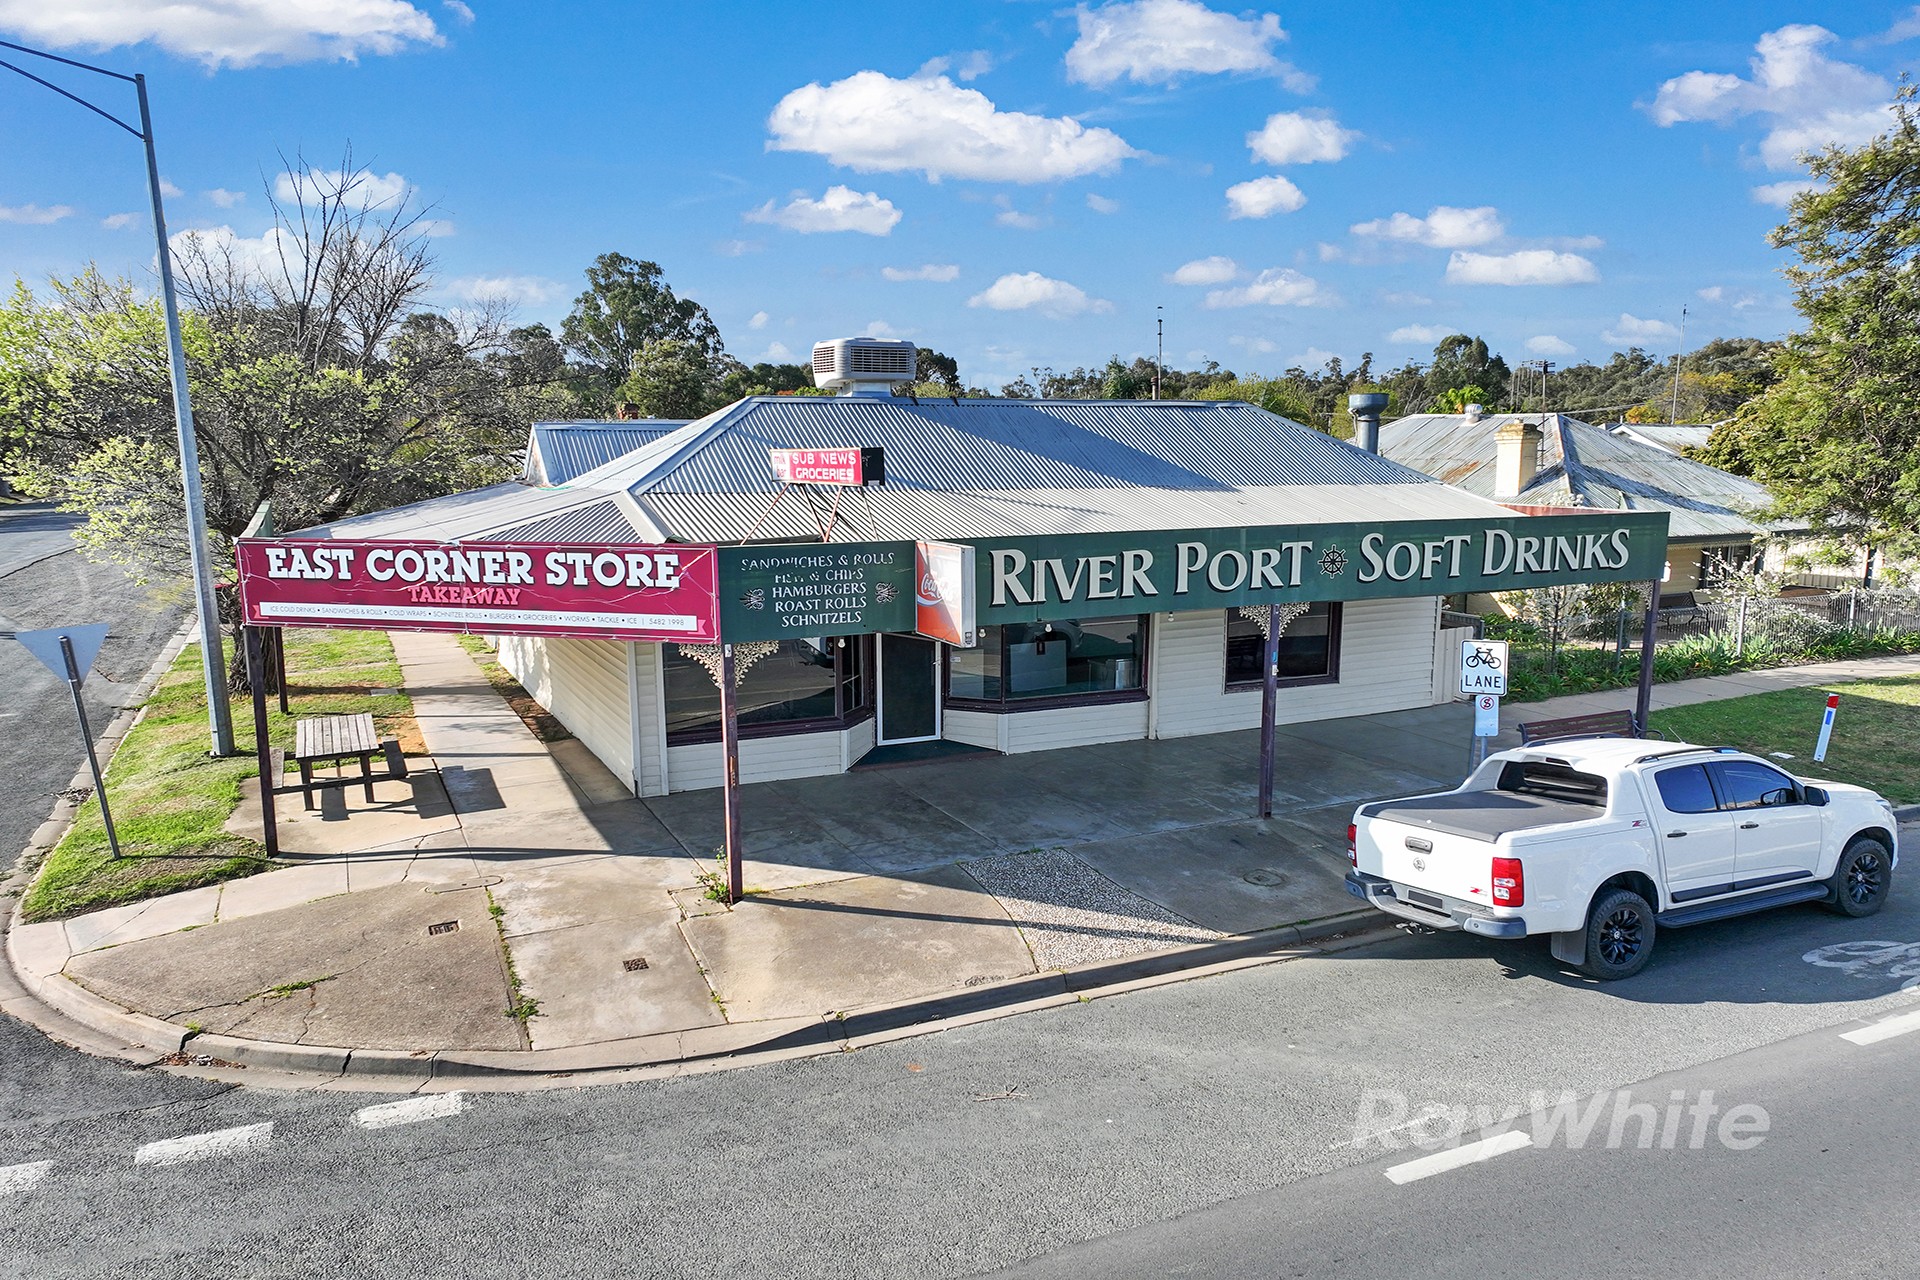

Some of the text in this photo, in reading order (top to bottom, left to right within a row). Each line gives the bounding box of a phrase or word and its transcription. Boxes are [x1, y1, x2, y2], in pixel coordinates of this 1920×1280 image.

[792, 452, 857, 465] SUB NEWS
[795, 468, 855, 481] GROCERIES
[265, 547, 680, 588] EAST CORNER STORE
[741, 552, 895, 572] SANDWICHES & ROLLS
[988, 548, 1159, 608] RIVER
[1174, 541, 1314, 595] PORT
[1357, 532, 1472, 583] SOFT
[1481, 528, 1631, 576] DRINKS
[825, 568, 864, 581] CHIPS
[408, 586, 521, 606] TAKEAWAY
[772, 582, 867, 598] HAMBURGERS
[775, 596, 867, 613] ROAST ROLLS
[270, 605, 279, 613] ICE
[322, 607, 360, 615] SANDWICHES
[433, 611, 464, 619] SCHNITZEL
[489, 612, 516, 620] BURGERS
[523, 613, 557, 622] GROCERIES
[564, 615, 590, 623] WORMS
[597, 616, 619, 624] TACKLE
[627, 617, 637, 625] ICE
[649, 618, 666, 626] 5482
[781, 611, 862, 628] SCHNITZELS
[1465, 674, 1502, 689] LANE
